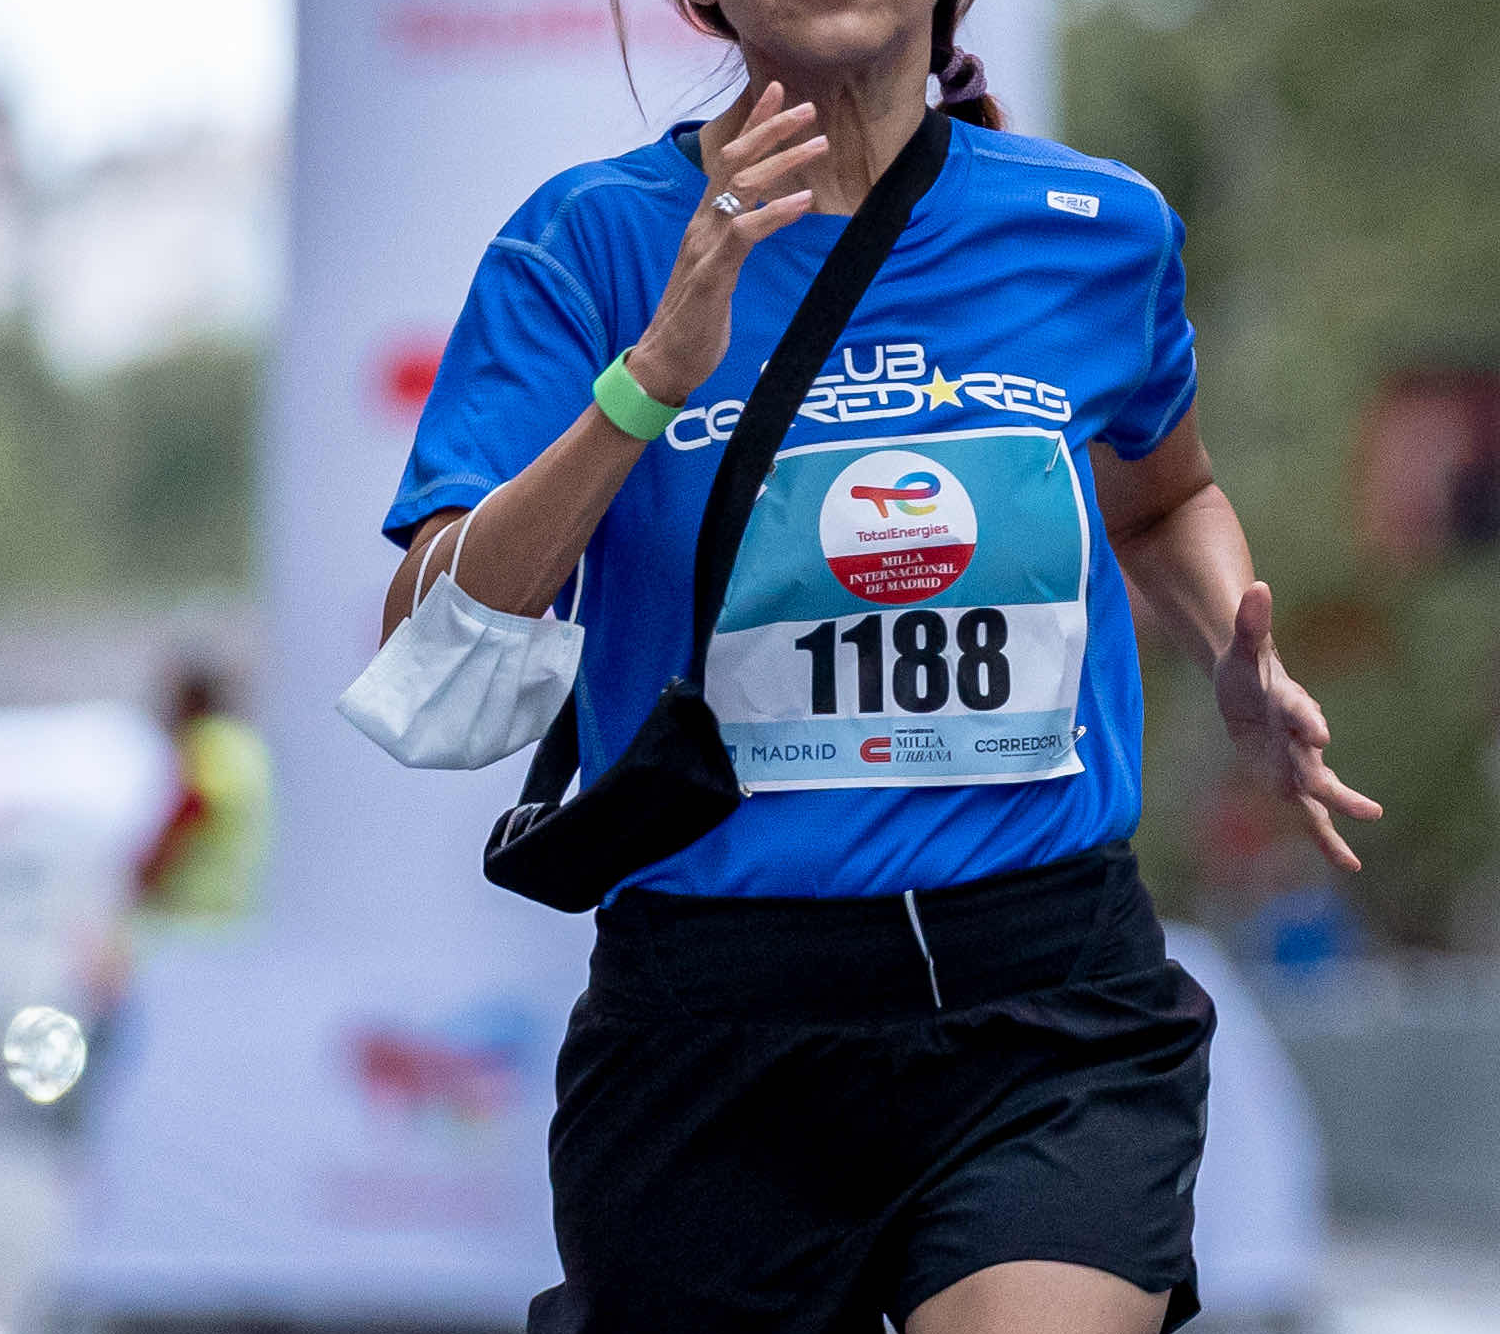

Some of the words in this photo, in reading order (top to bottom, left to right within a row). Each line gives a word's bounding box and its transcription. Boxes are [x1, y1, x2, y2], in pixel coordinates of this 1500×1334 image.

[855, 523, 949, 543] TotalEnergies
[882, 552, 924, 567] MILLA
[866, 582, 885, 595] DE
[887, 576, 942, 592] MADRID
[794, 607, 1011, 715] 1188
[895, 736, 946, 748] MILLA
[751, 743, 837, 762] MADRID
